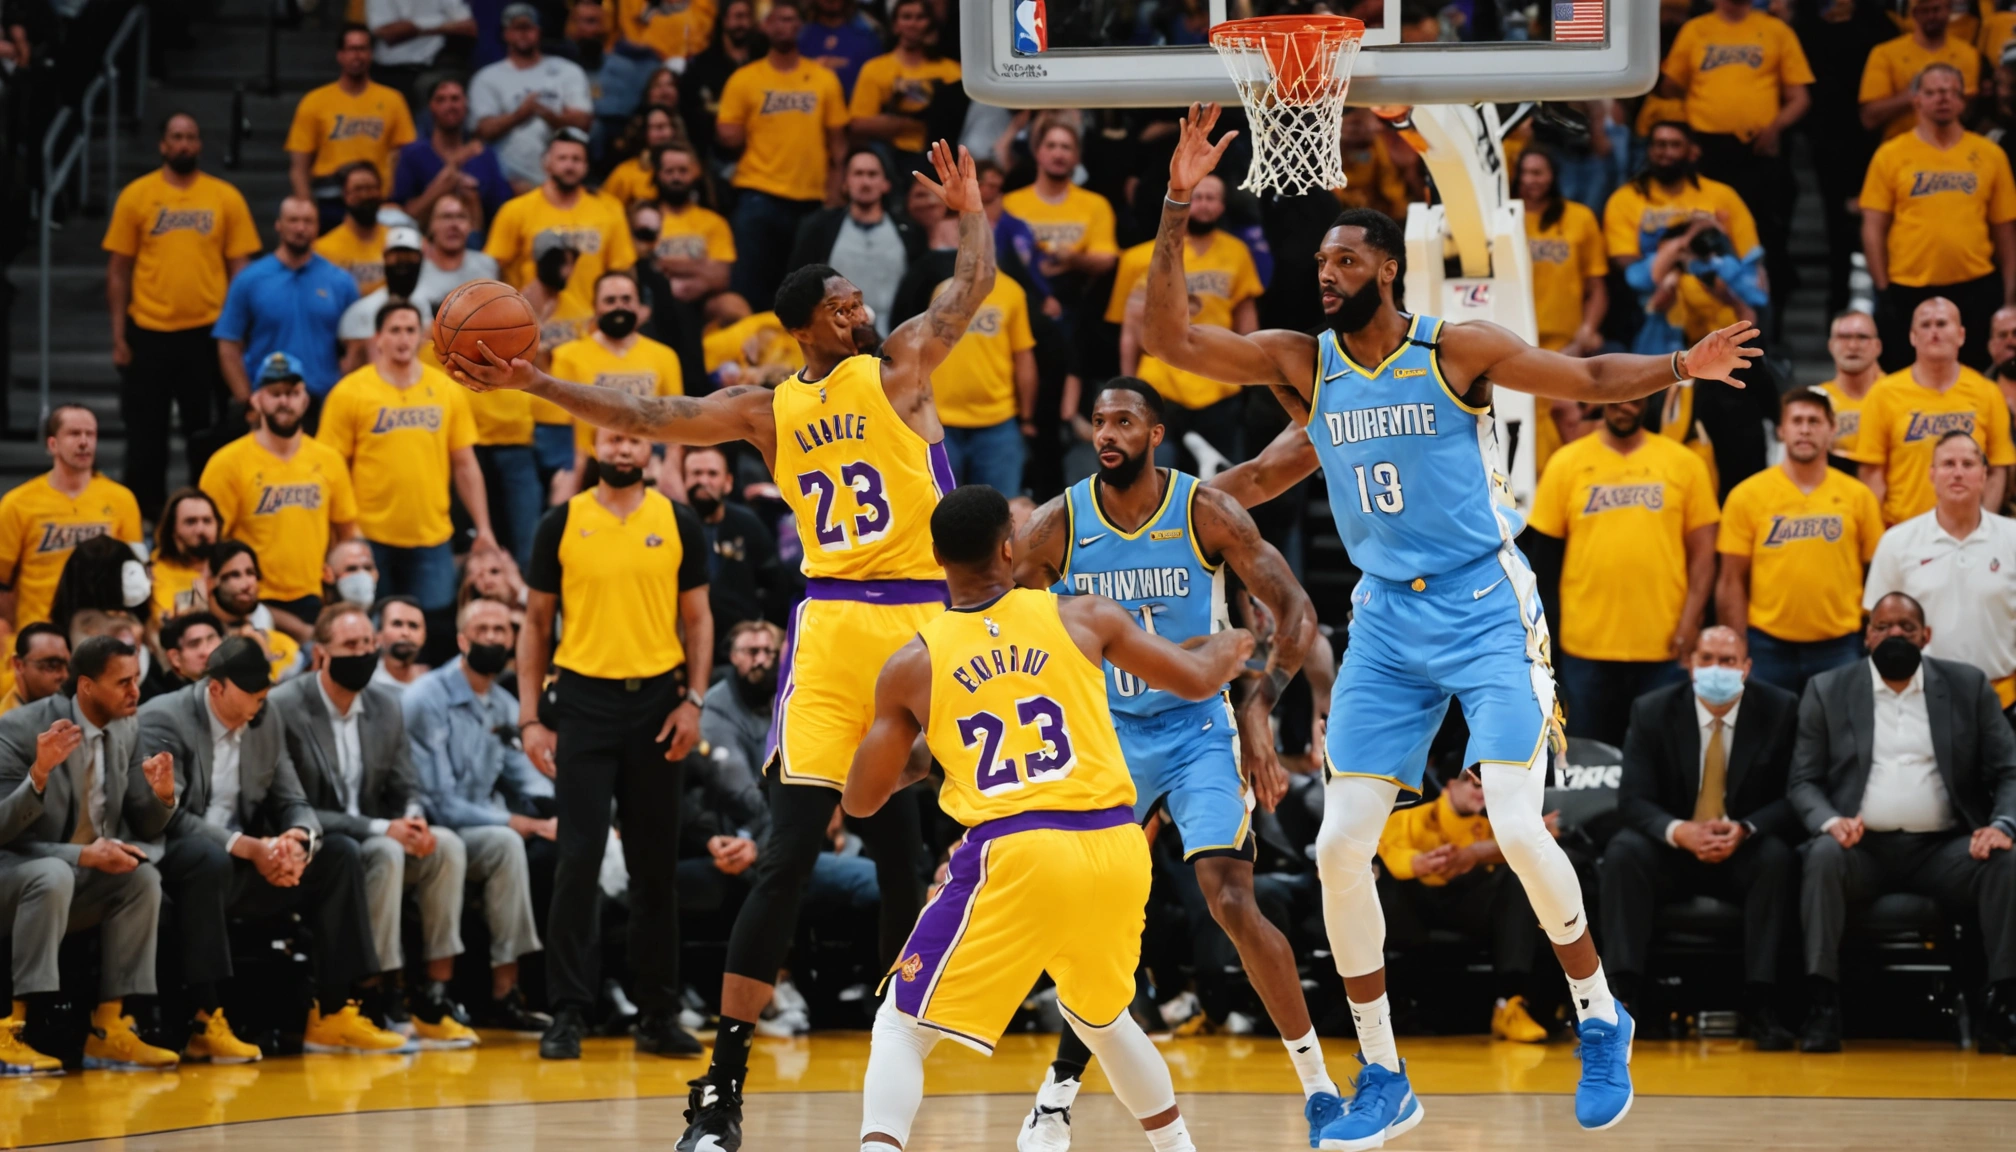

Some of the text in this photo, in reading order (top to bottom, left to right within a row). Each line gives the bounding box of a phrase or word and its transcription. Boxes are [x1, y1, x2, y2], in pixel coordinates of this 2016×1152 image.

[797, 459, 894, 552] 23
[1352, 462, 1404, 514] 13
[956, 694, 1077, 798] 23
